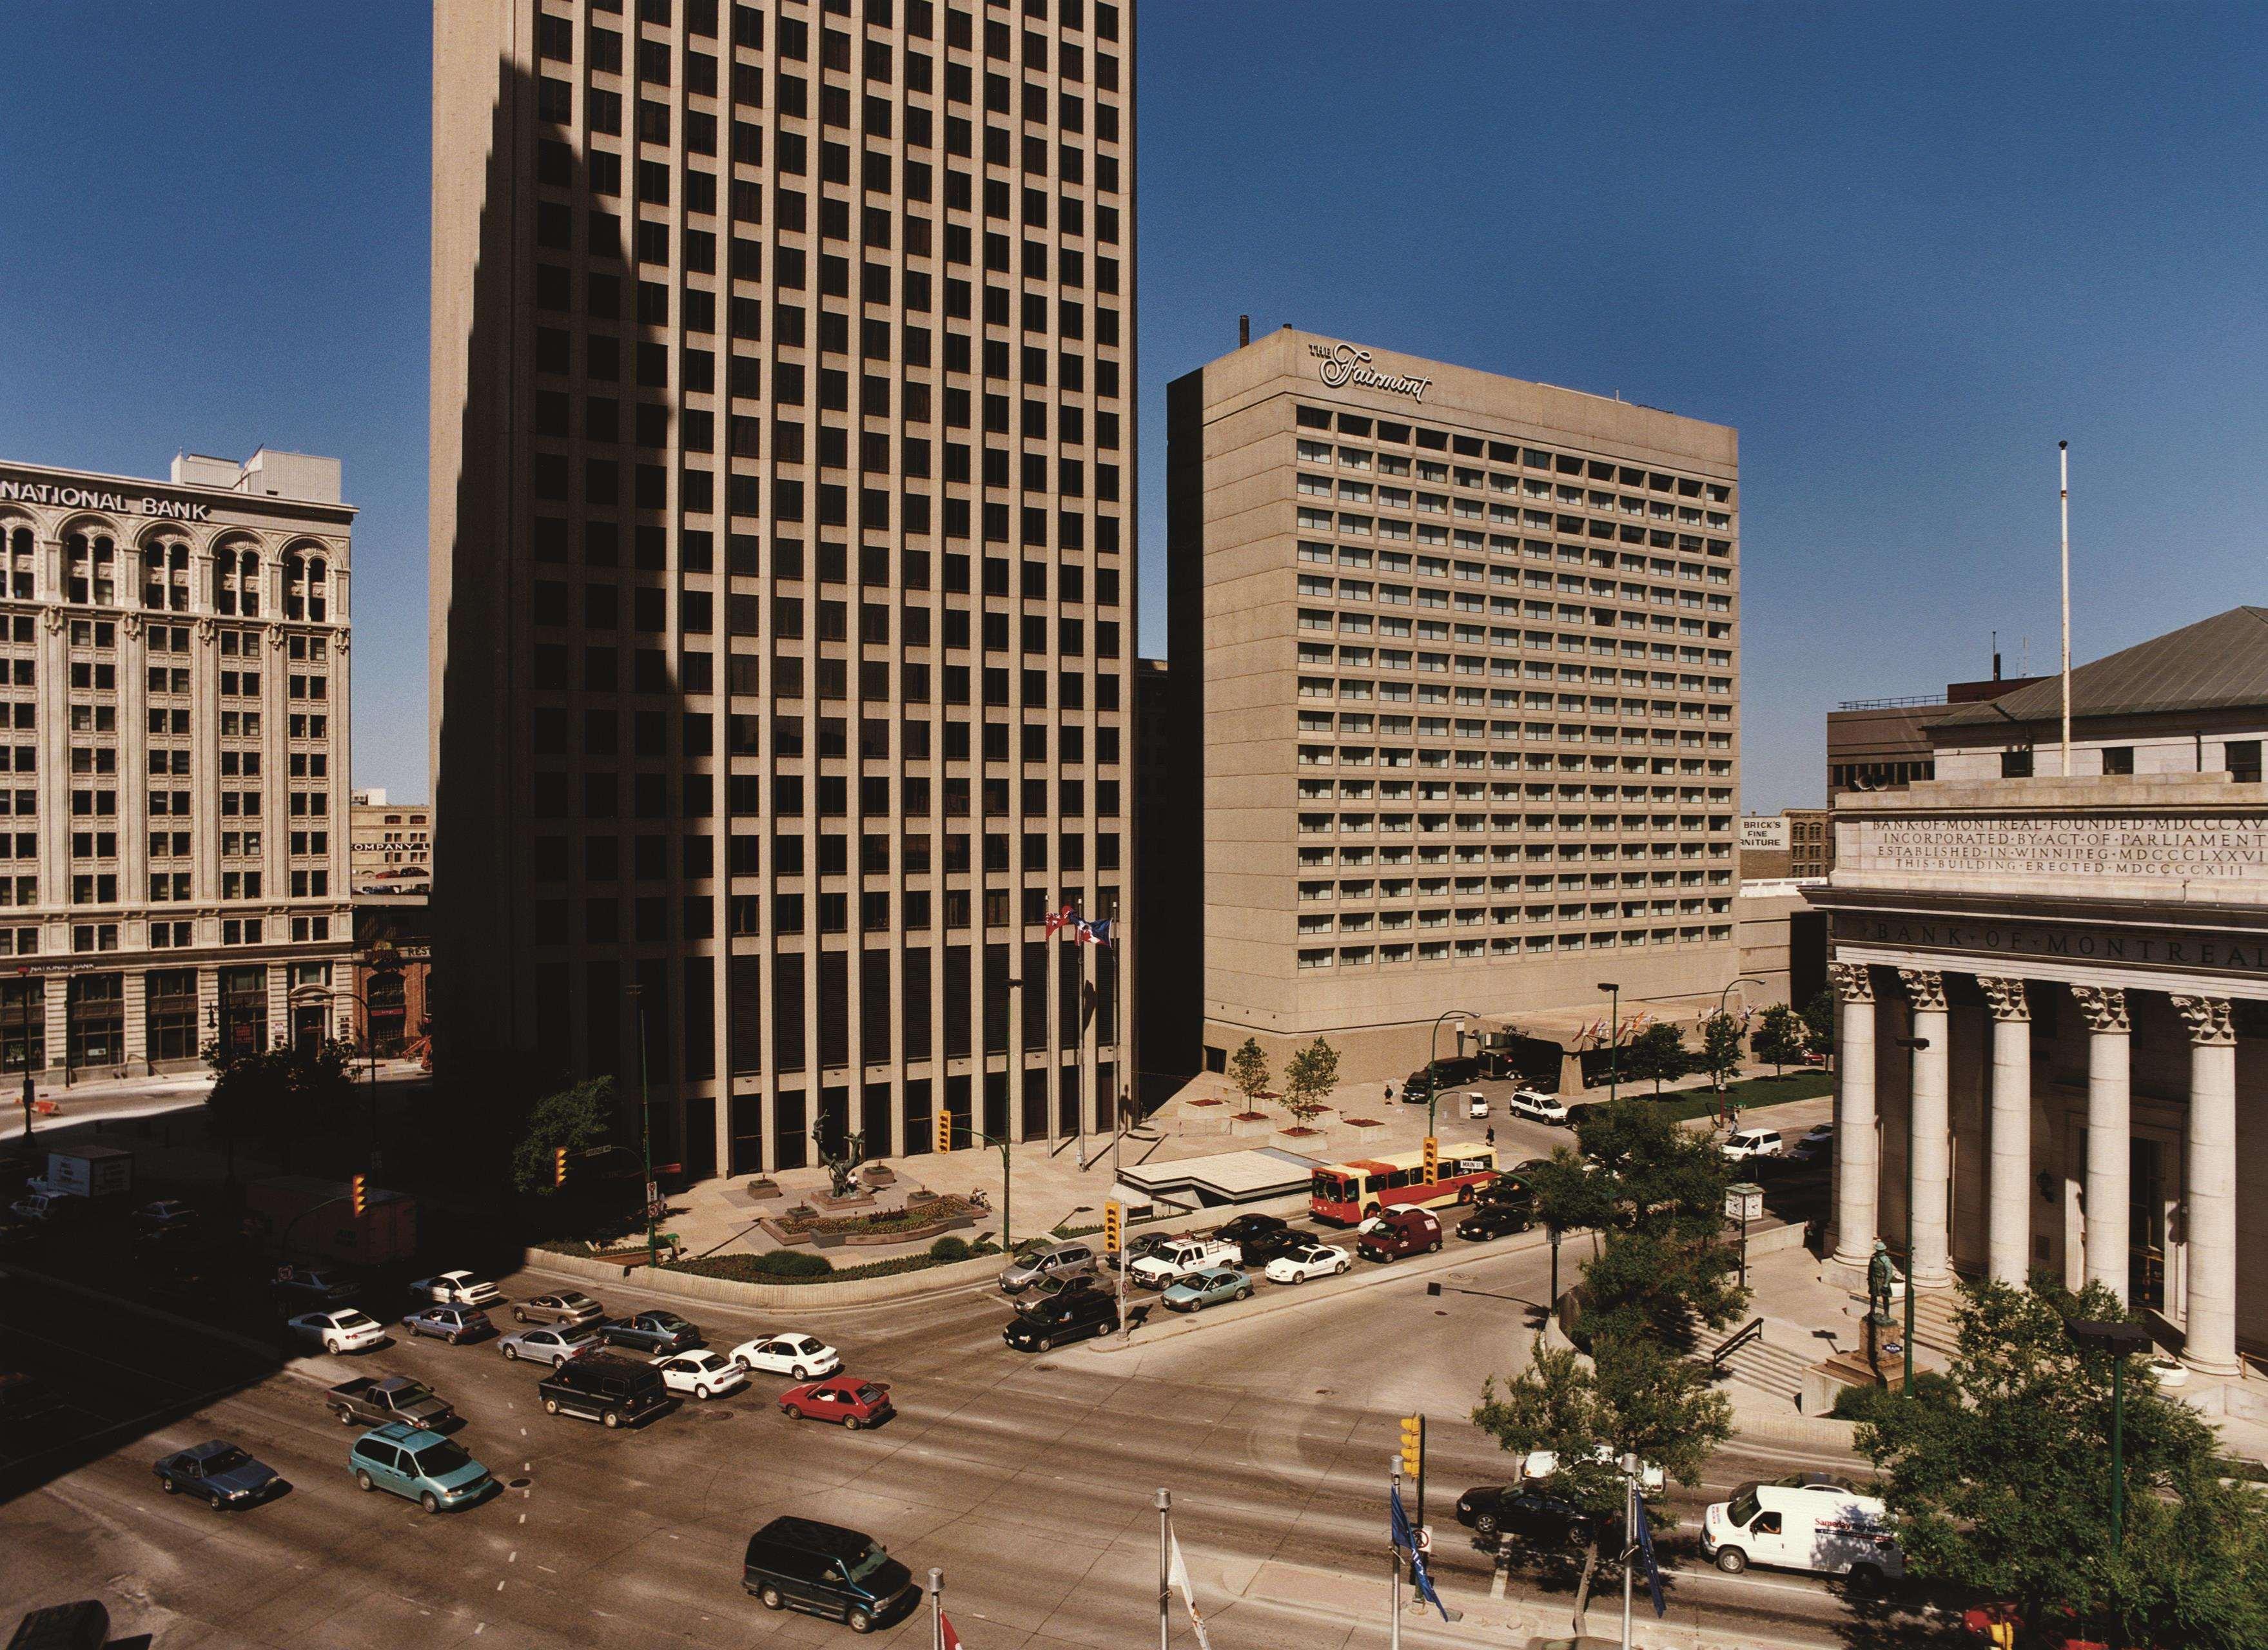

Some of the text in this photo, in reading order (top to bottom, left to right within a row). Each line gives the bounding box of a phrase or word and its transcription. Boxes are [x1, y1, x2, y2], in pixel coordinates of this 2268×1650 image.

[1309, 343, 1432, 403] THE Fairmont
[1, 481, 209, 521] NATIONAL BANK
[1873, 819, 1915, 830] BANK
[1921, 819, 1940, 830] OF
[1946, 819, 2042, 830] MONTREAL
[2050, 818, 2144, 830] FOUNDED
[1884, 833, 2267, 847] INCORPORATED BY ACT OF PARLIAMENT
[1878, 846, 2263, 862] ESTABLISHED IN WINNIPEG MDCCCLXXVI
[1896, 859, 2242, 876] THIS BUILDING ERECTED MDCCCCXIII
[1877, 924, 2268, 967] BANK OF MONTREAL
[30, 964, 68, 973] NATIONAL
